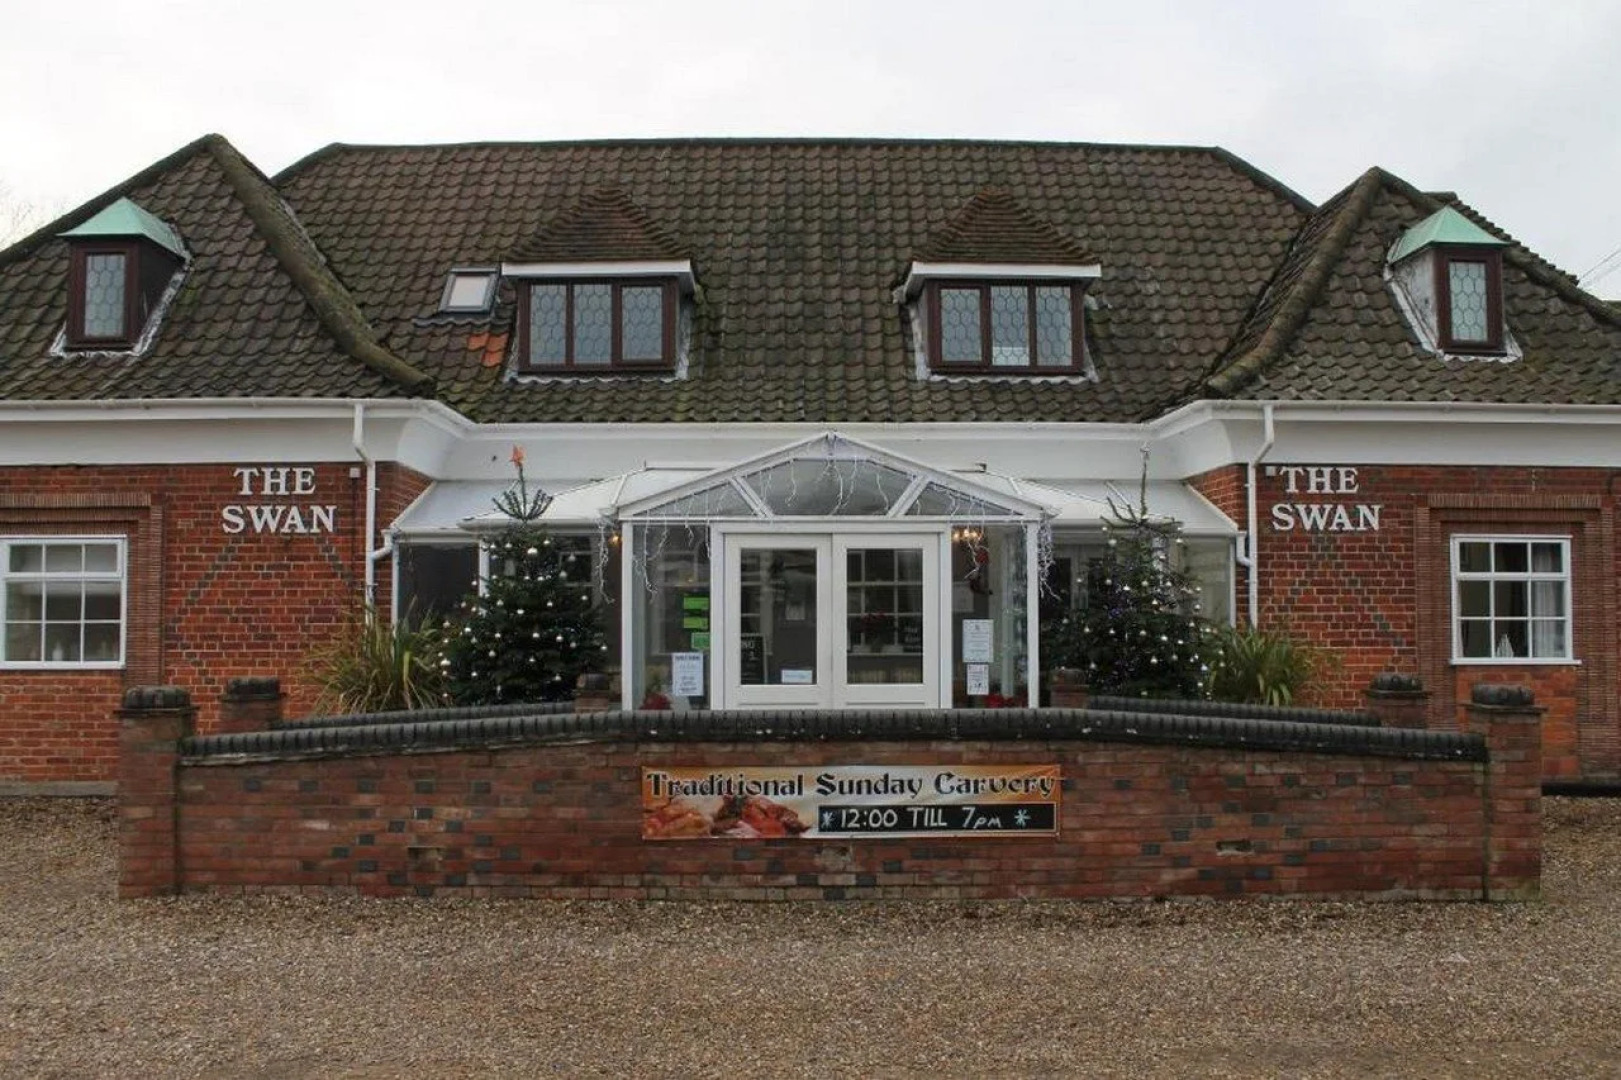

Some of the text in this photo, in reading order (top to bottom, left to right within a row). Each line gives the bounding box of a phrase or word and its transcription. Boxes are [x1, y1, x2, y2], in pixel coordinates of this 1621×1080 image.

[233, 467, 316, 496] THE
[1279, 466, 1360, 494] THE
[222, 505, 337, 534] SWAN
[1272, 503, 1382, 531] SWAN
[646, 772, 1055, 799] Traditional Sunday Carvery
[840, 808, 899, 829] 12:00
[907, 806, 948, 828] TILL
